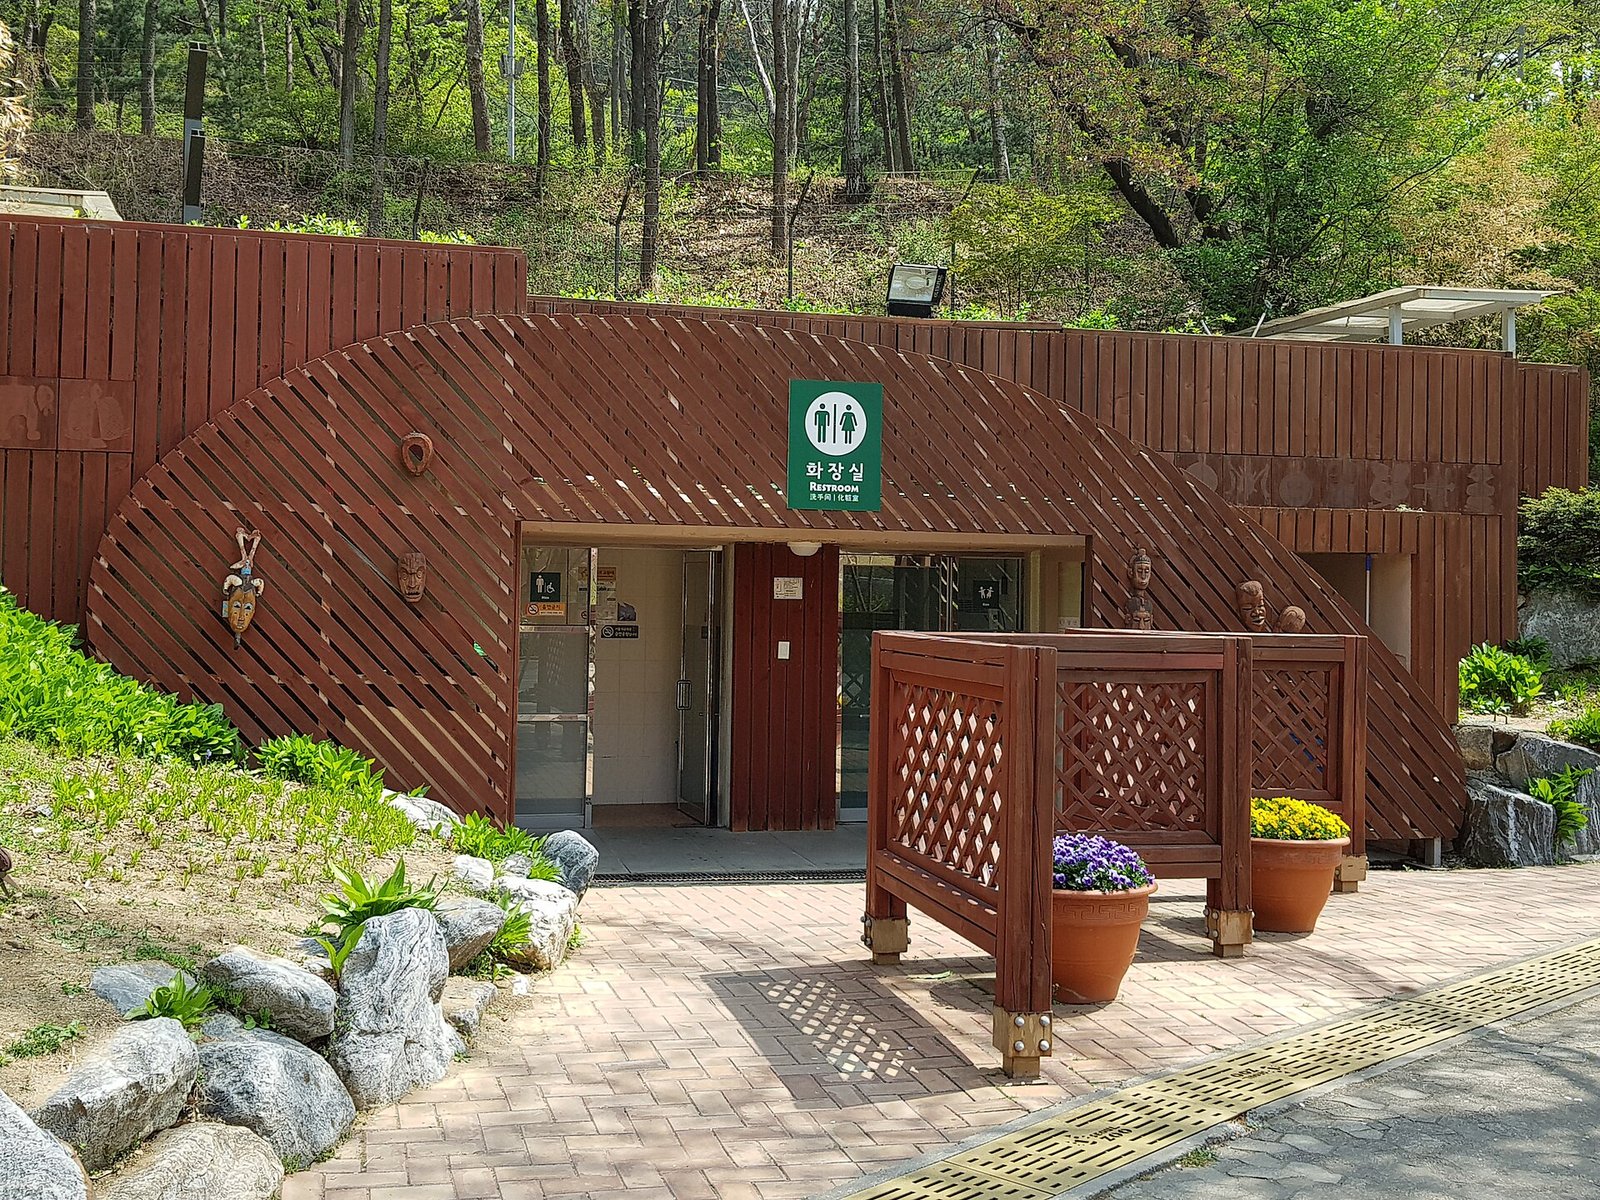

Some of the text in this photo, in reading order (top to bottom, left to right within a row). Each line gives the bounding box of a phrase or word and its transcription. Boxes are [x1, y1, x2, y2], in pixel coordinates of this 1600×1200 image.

[806, 461, 863, 481] 화장실
[809, 482, 859, 492] RESTROOM
[1099, 1128, 1132, 1141] ZOO
